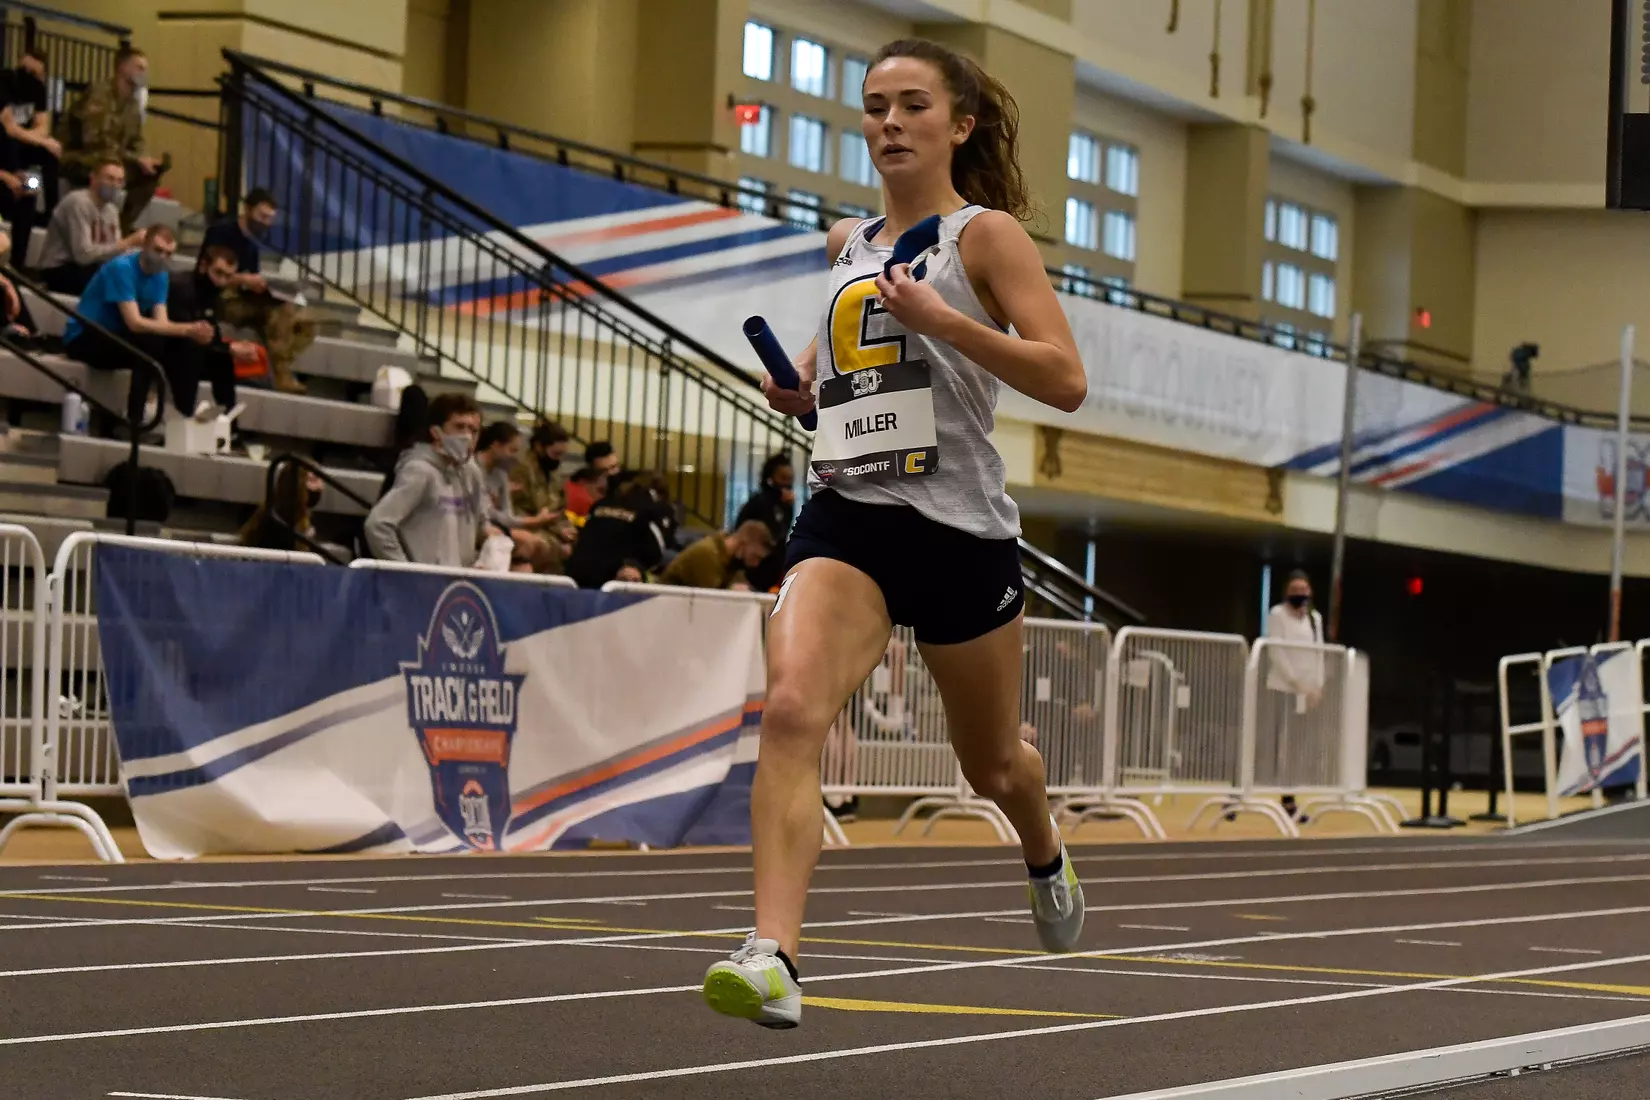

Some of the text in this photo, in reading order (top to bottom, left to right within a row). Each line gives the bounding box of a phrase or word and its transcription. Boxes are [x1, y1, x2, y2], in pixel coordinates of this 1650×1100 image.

[845, 412, 898, 440] MILLER
[842, 460, 890, 476] #SOCONTF
[904, 451, 927, 474] C
[411, 675, 467, 722] TRACK
